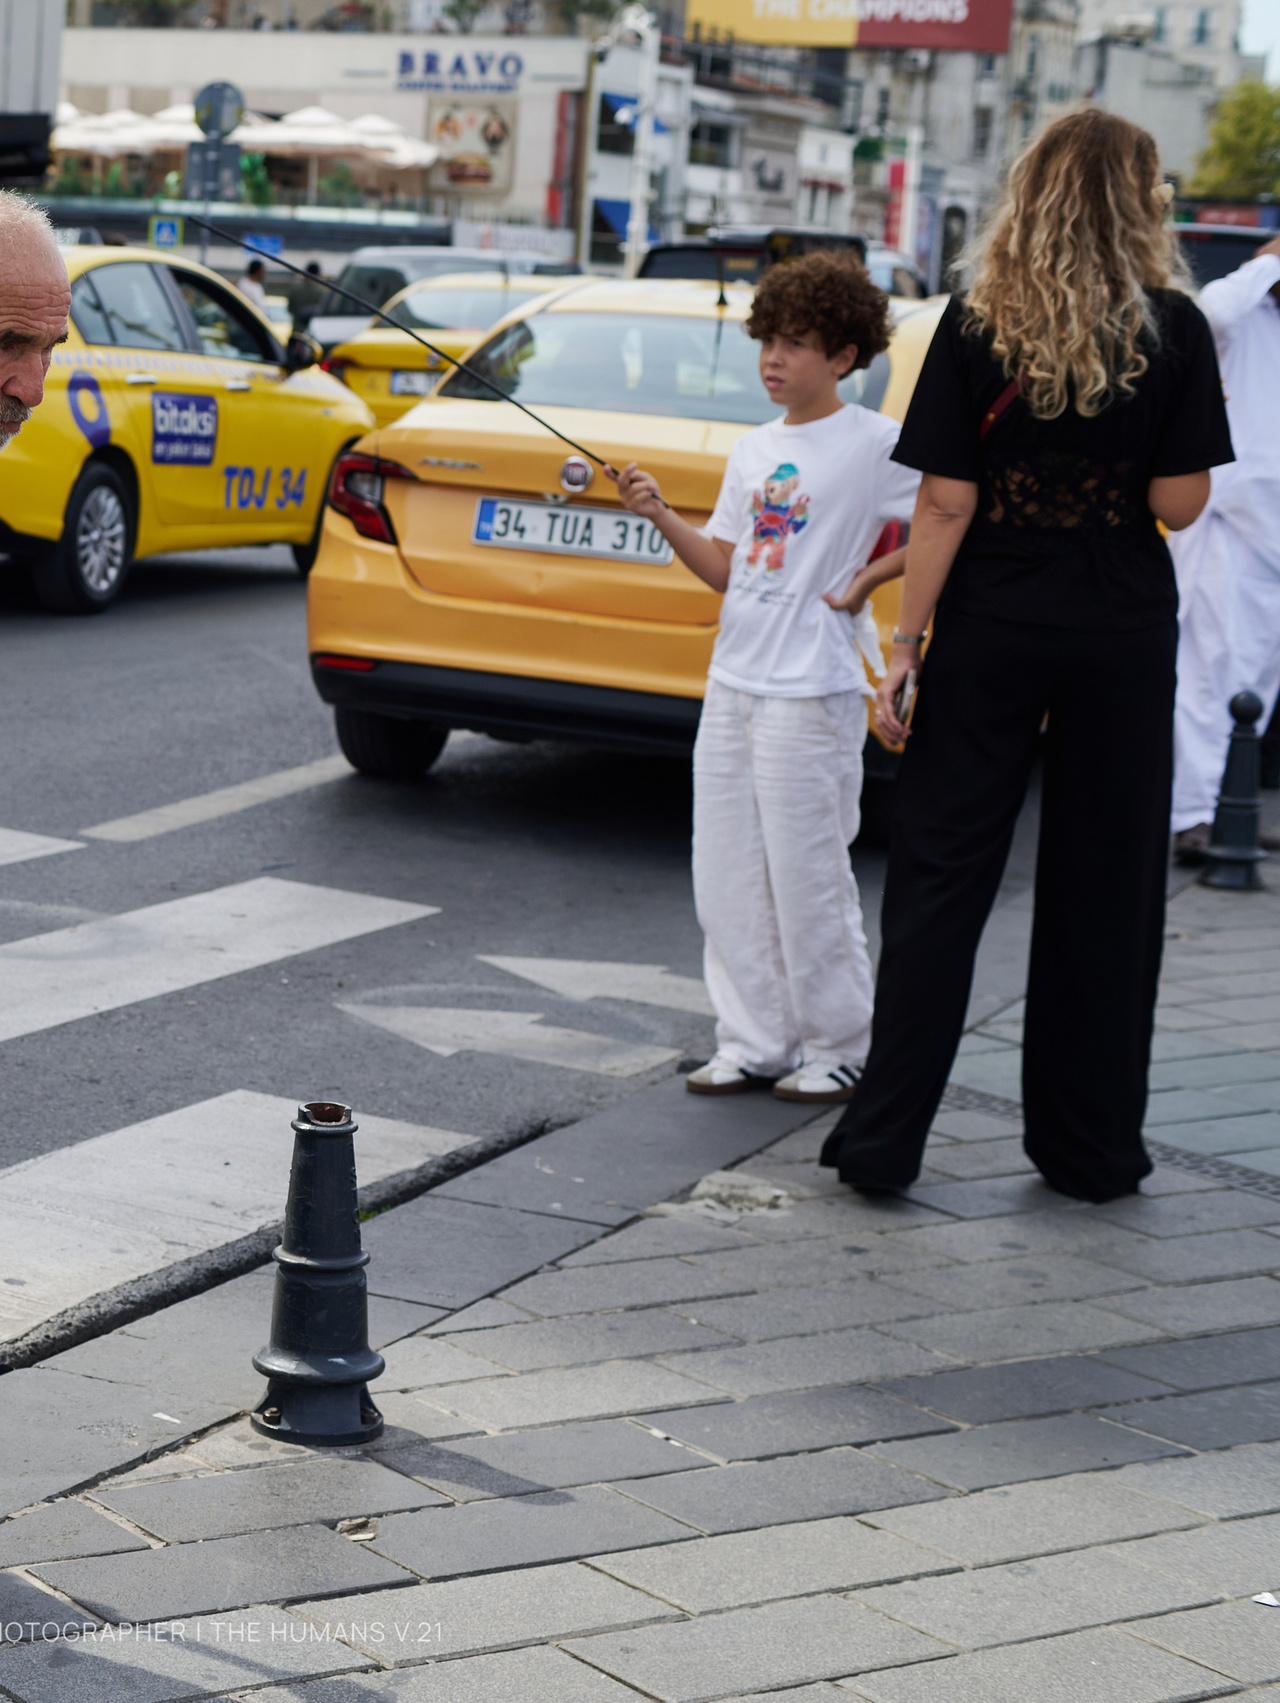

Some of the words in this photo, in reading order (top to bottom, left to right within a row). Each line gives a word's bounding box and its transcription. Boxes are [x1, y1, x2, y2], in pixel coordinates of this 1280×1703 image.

[398, 51, 524, 78] BRAVO
[154, 398, 217, 437] bitaksi
[275, 467, 307, 510] 34
[495, 508, 527, 539] 34
[547, 513, 592, 547] TUA
[612, 520, 666, 554] 310
